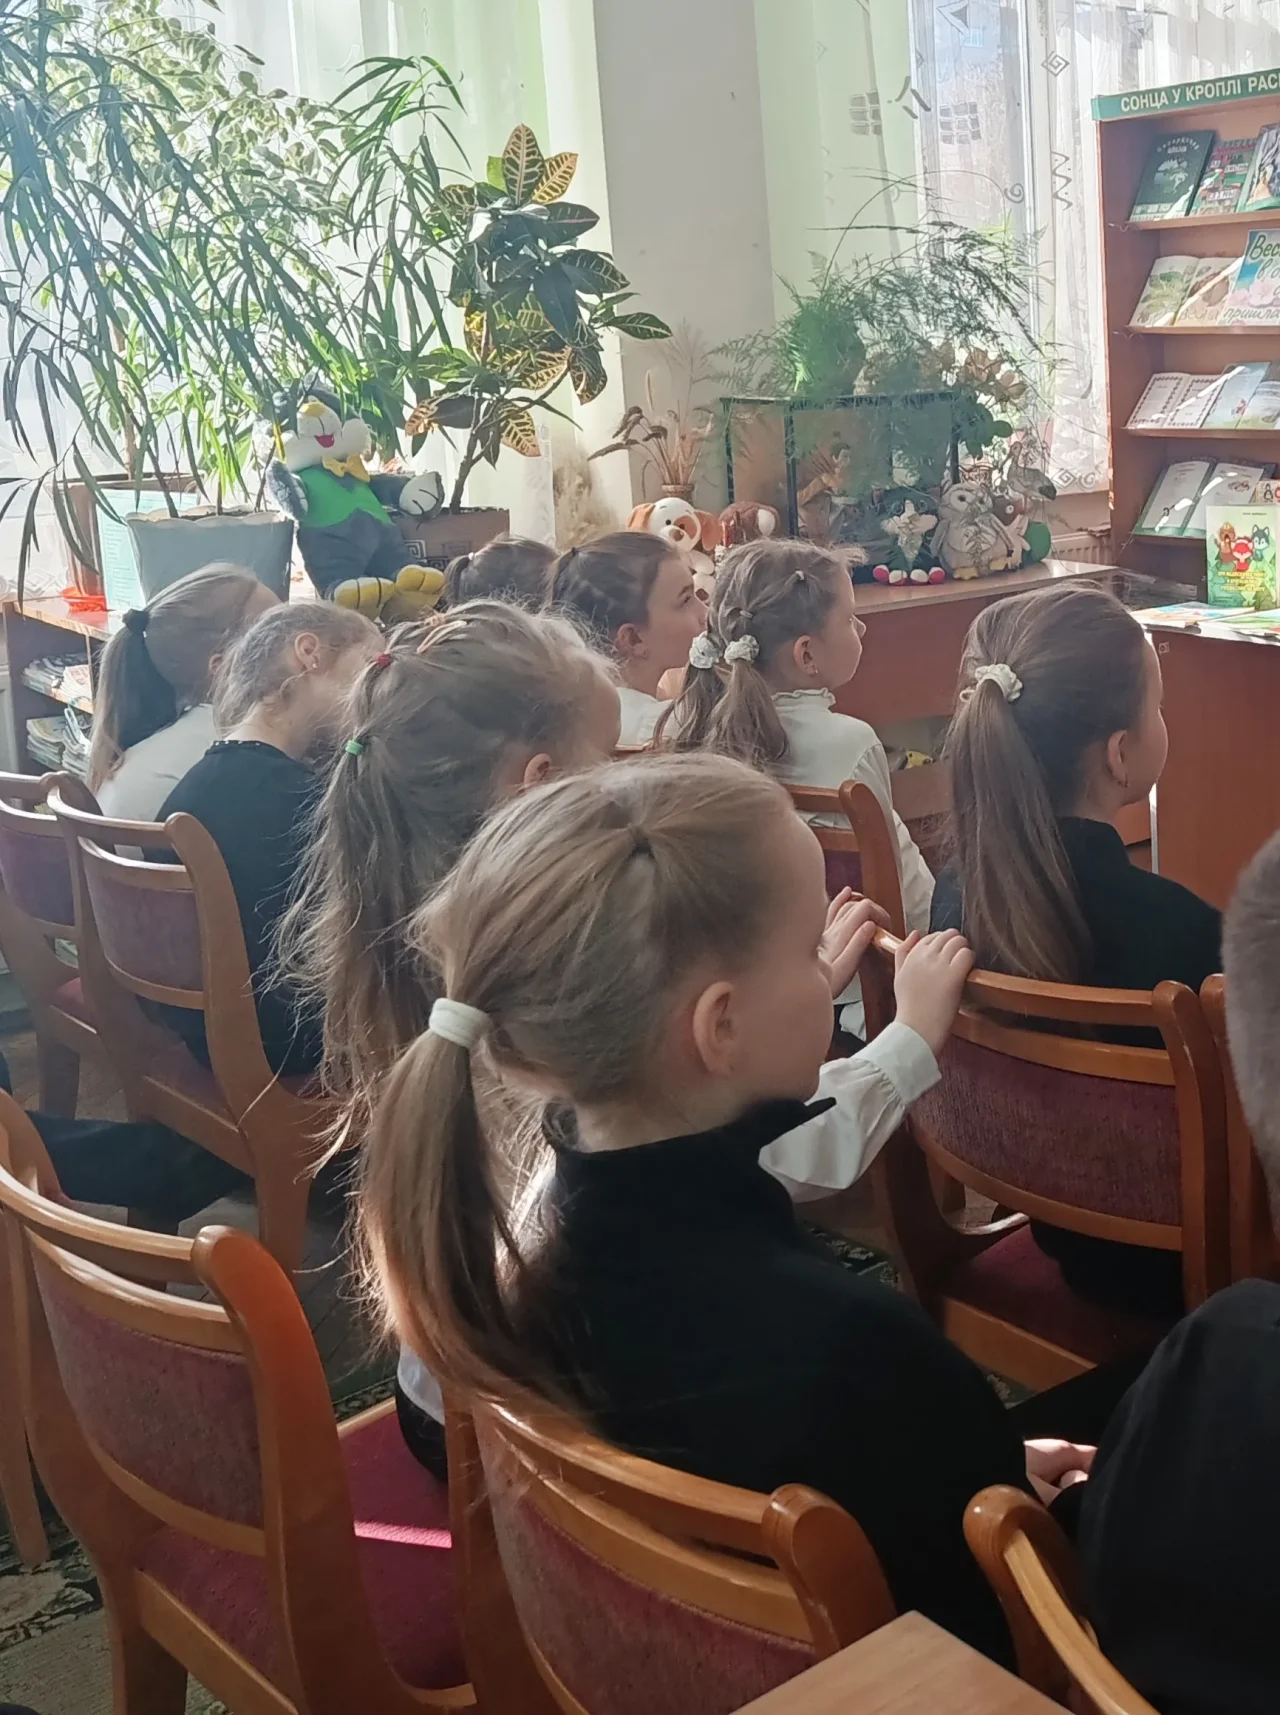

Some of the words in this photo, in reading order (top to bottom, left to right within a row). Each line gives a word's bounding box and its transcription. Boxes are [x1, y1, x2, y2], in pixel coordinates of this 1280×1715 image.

[1121, 95, 1168, 112] СОНЦА
[1172, 88, 1181, 104] У
[1185, 82, 1241, 102] КРОПЛІ
[1223, 308, 1279, 324] пришла
